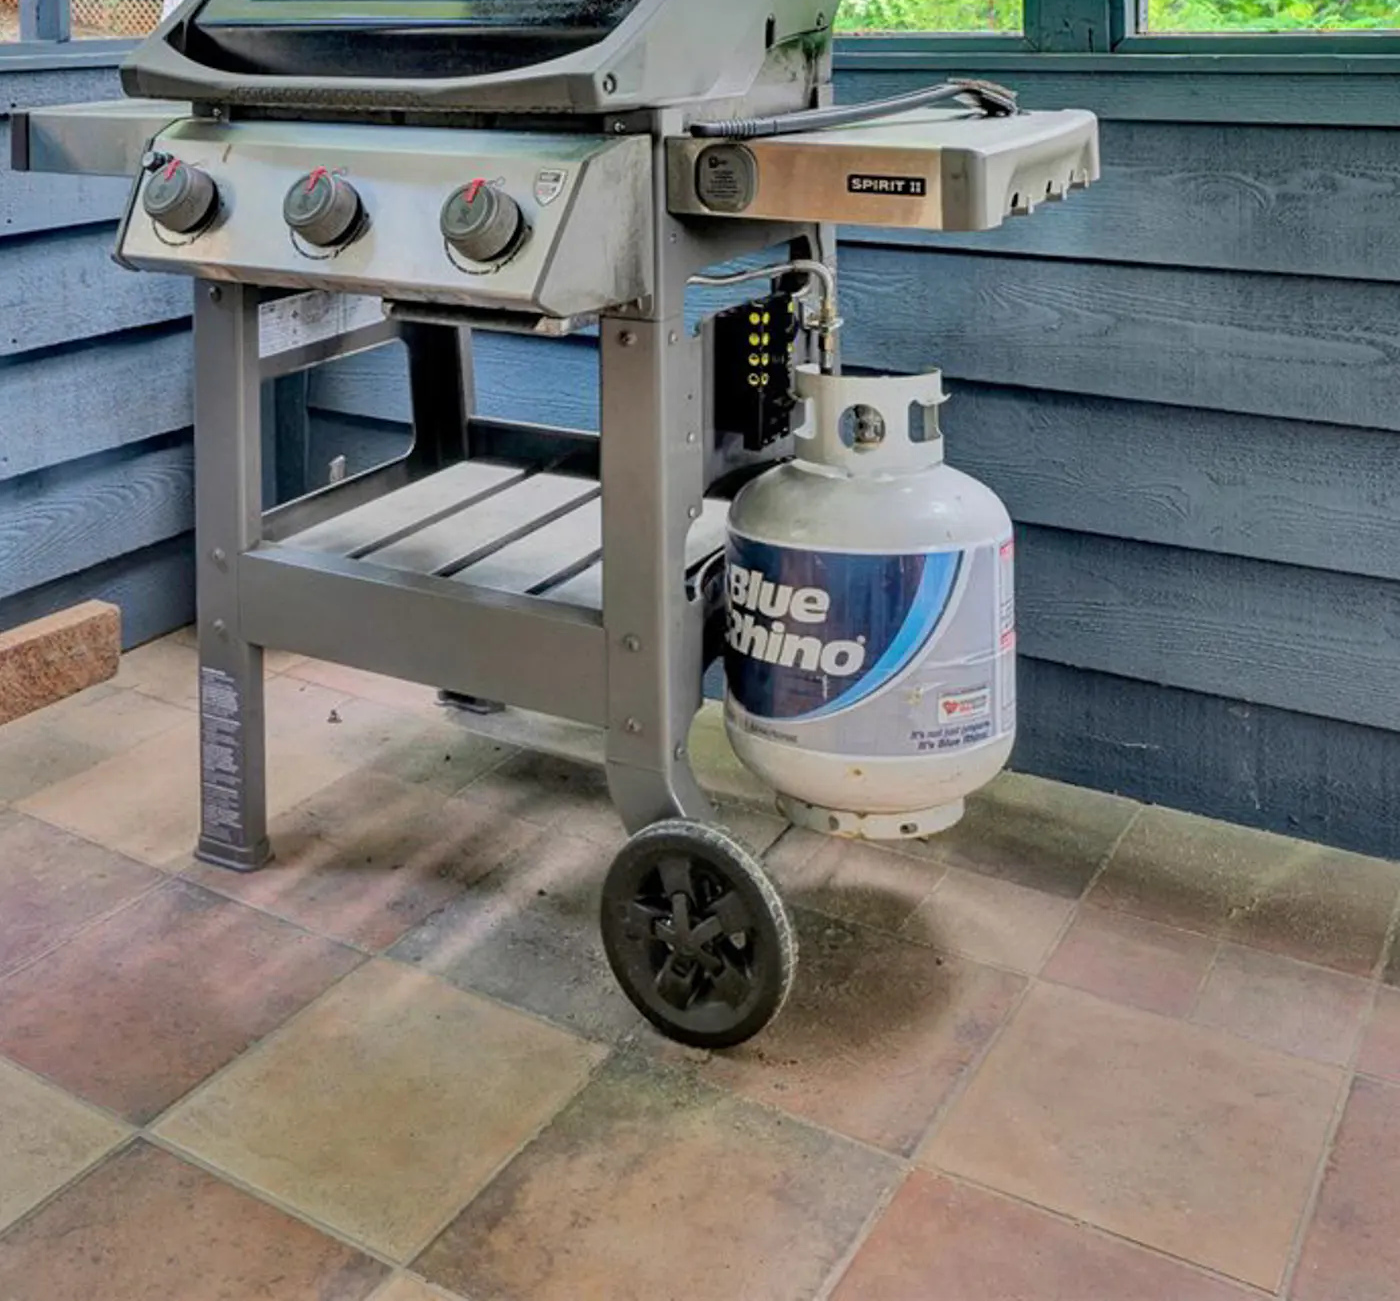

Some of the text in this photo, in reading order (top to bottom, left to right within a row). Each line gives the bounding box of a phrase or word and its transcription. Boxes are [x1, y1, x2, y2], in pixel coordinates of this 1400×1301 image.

[851, 178, 922, 193] SPIRIT II
[730, 563, 830, 623] Blue
